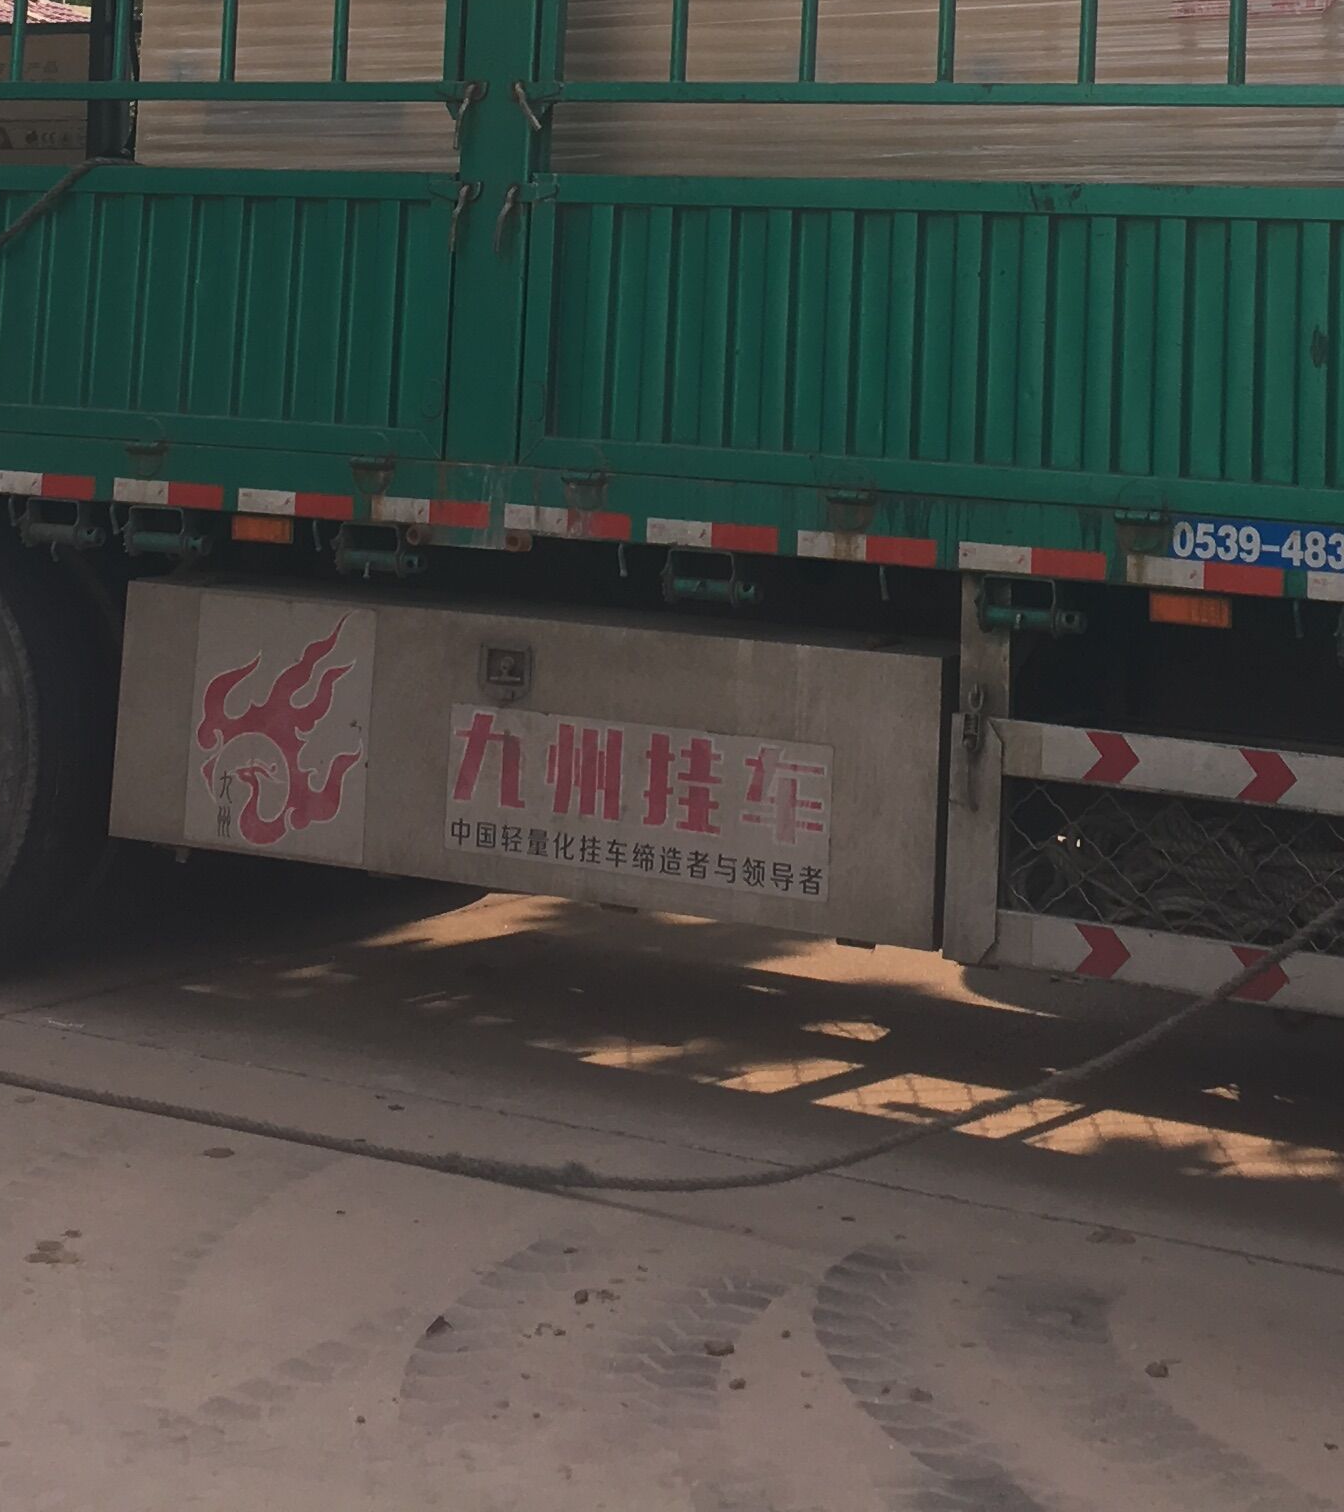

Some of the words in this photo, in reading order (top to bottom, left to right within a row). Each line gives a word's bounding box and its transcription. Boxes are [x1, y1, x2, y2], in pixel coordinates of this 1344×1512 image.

[451, 711, 827, 845] 九州挂车
[450, 817, 824, 896] 中国轻量化挂车缔造者与领导者
